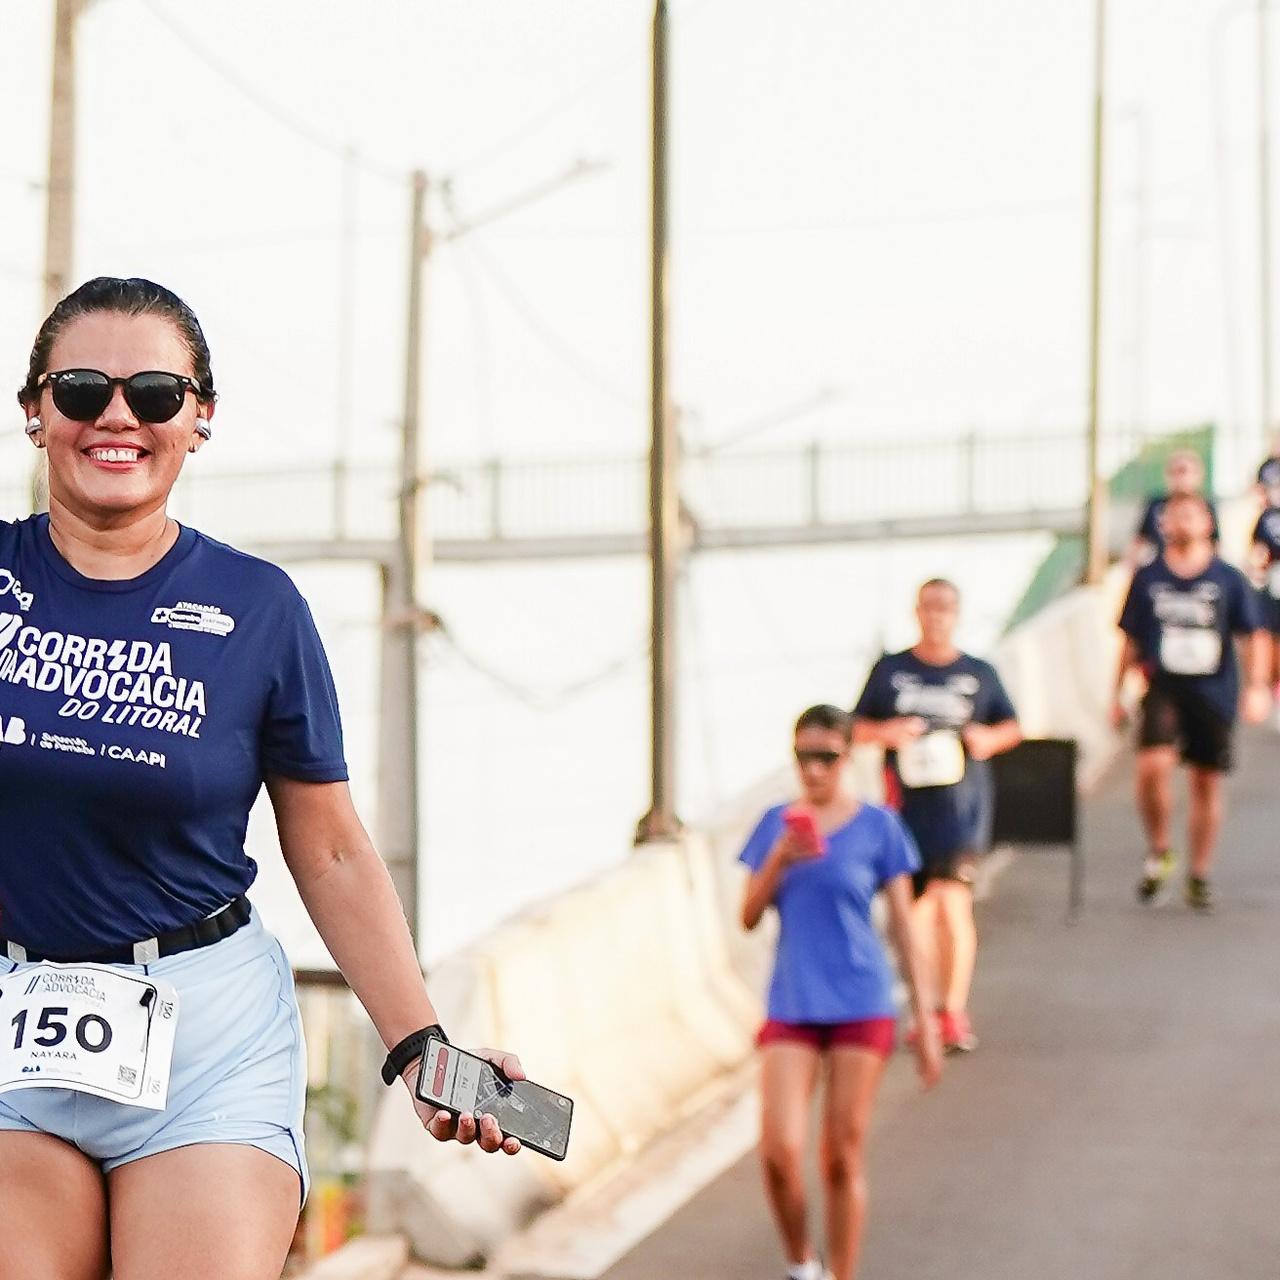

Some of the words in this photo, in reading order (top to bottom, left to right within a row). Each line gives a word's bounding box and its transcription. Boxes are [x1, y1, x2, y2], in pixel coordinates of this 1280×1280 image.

[12, 657, 207, 716] ADVOCACIA
[58, 698, 100, 720] DO
[101, 704, 203, 738] LITORAL
[108, 744, 167, 768] CAAPI
[11, 1007, 112, 1053] 150
